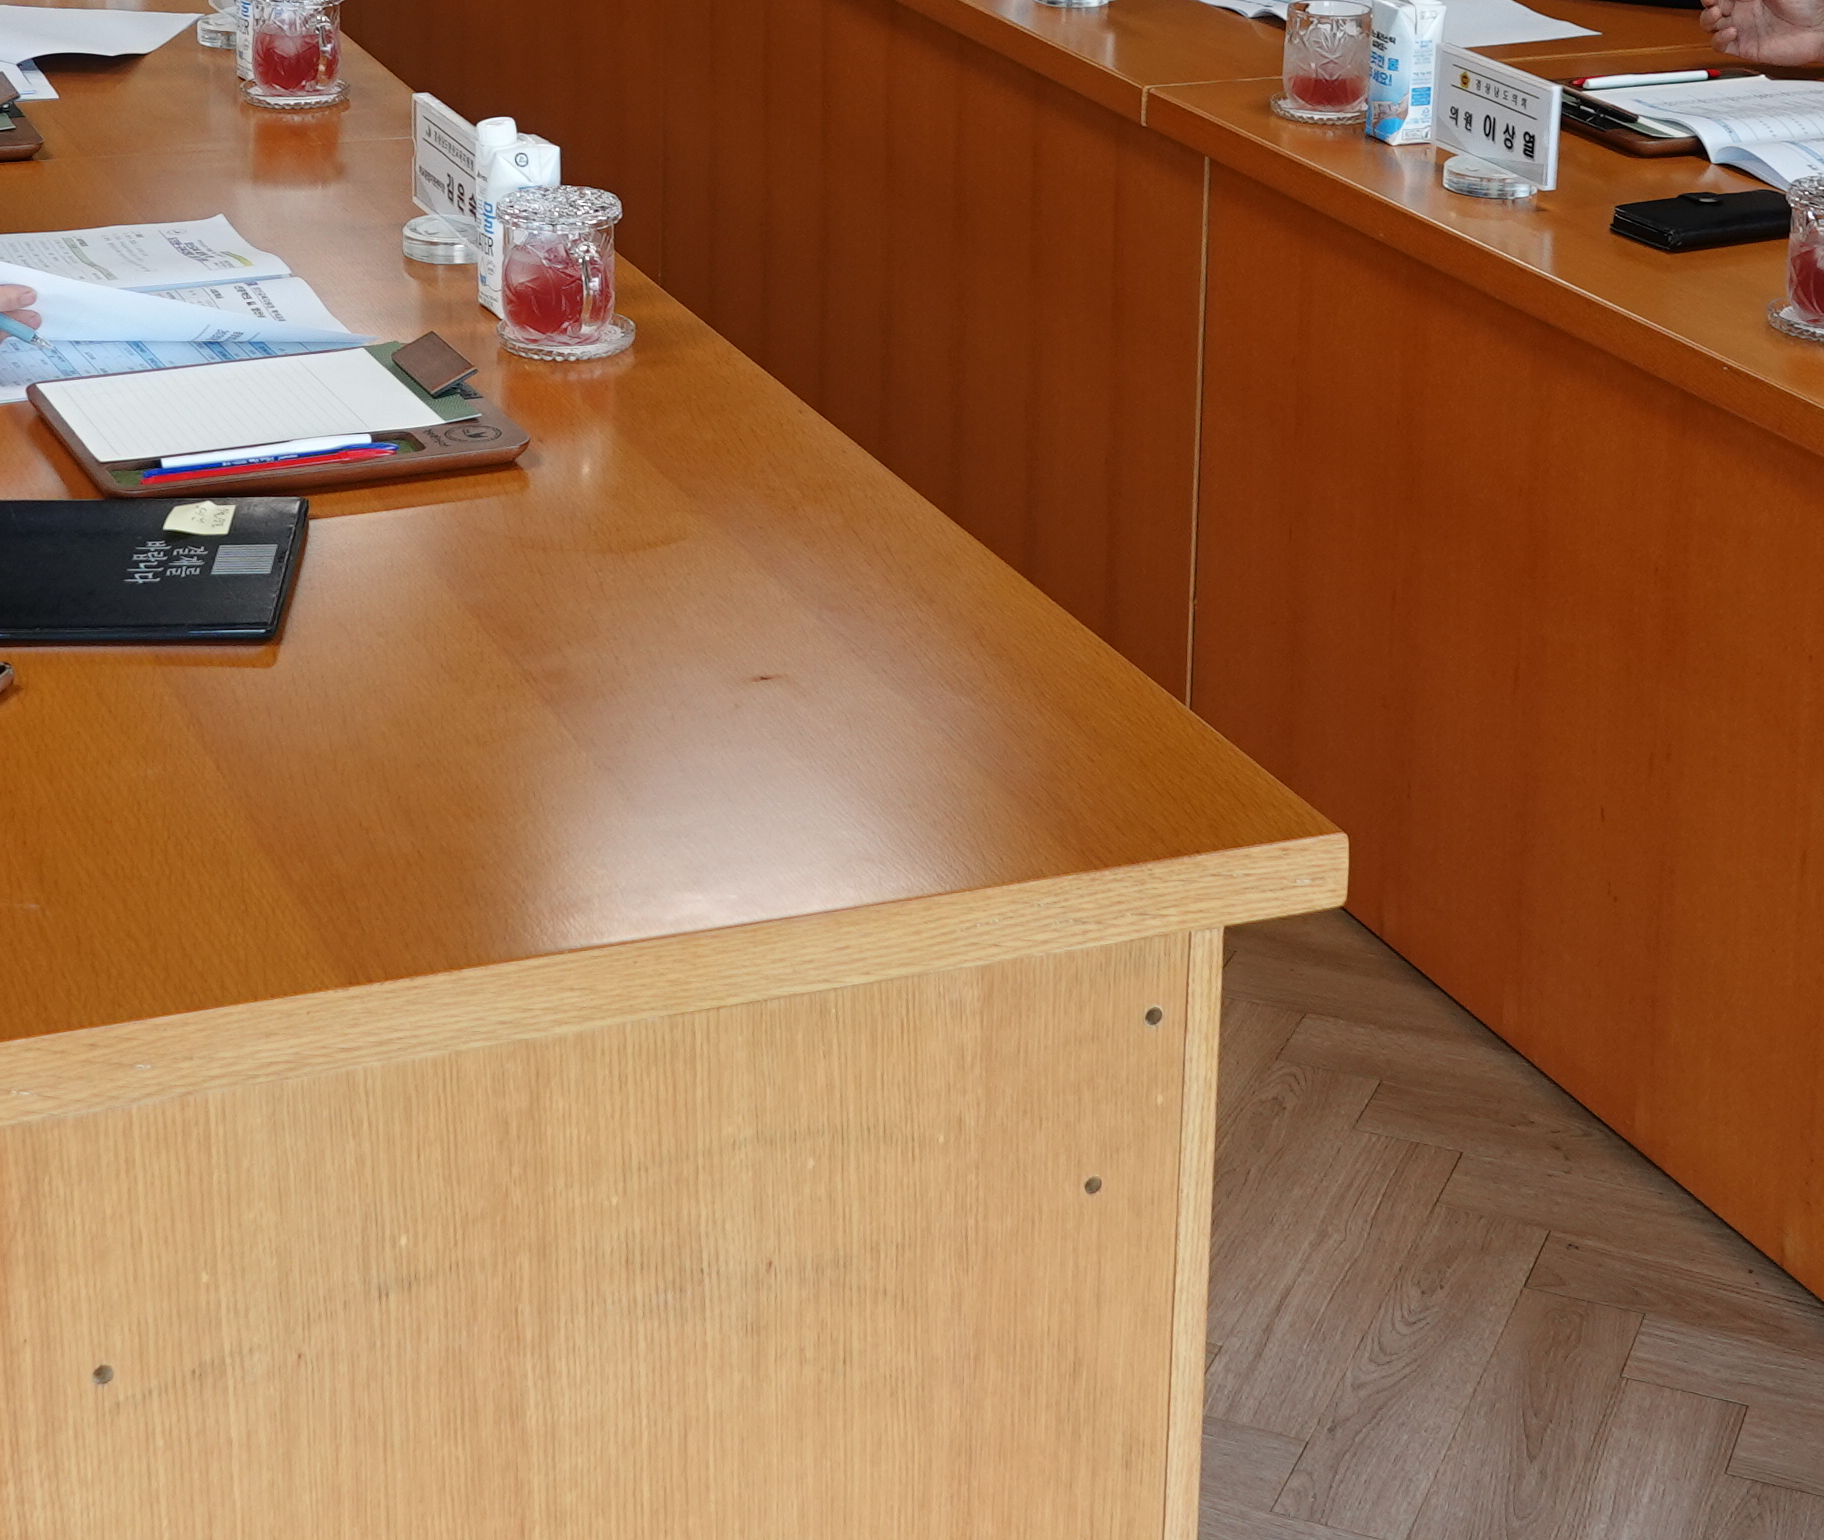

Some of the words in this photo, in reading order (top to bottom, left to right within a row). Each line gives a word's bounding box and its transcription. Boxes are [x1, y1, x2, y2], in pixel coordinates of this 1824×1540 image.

[1449, 105, 1473, 132] 의원
[1483, 114, 1536, 159] 이상열
[123, 539, 173, 584] 바랍니다
